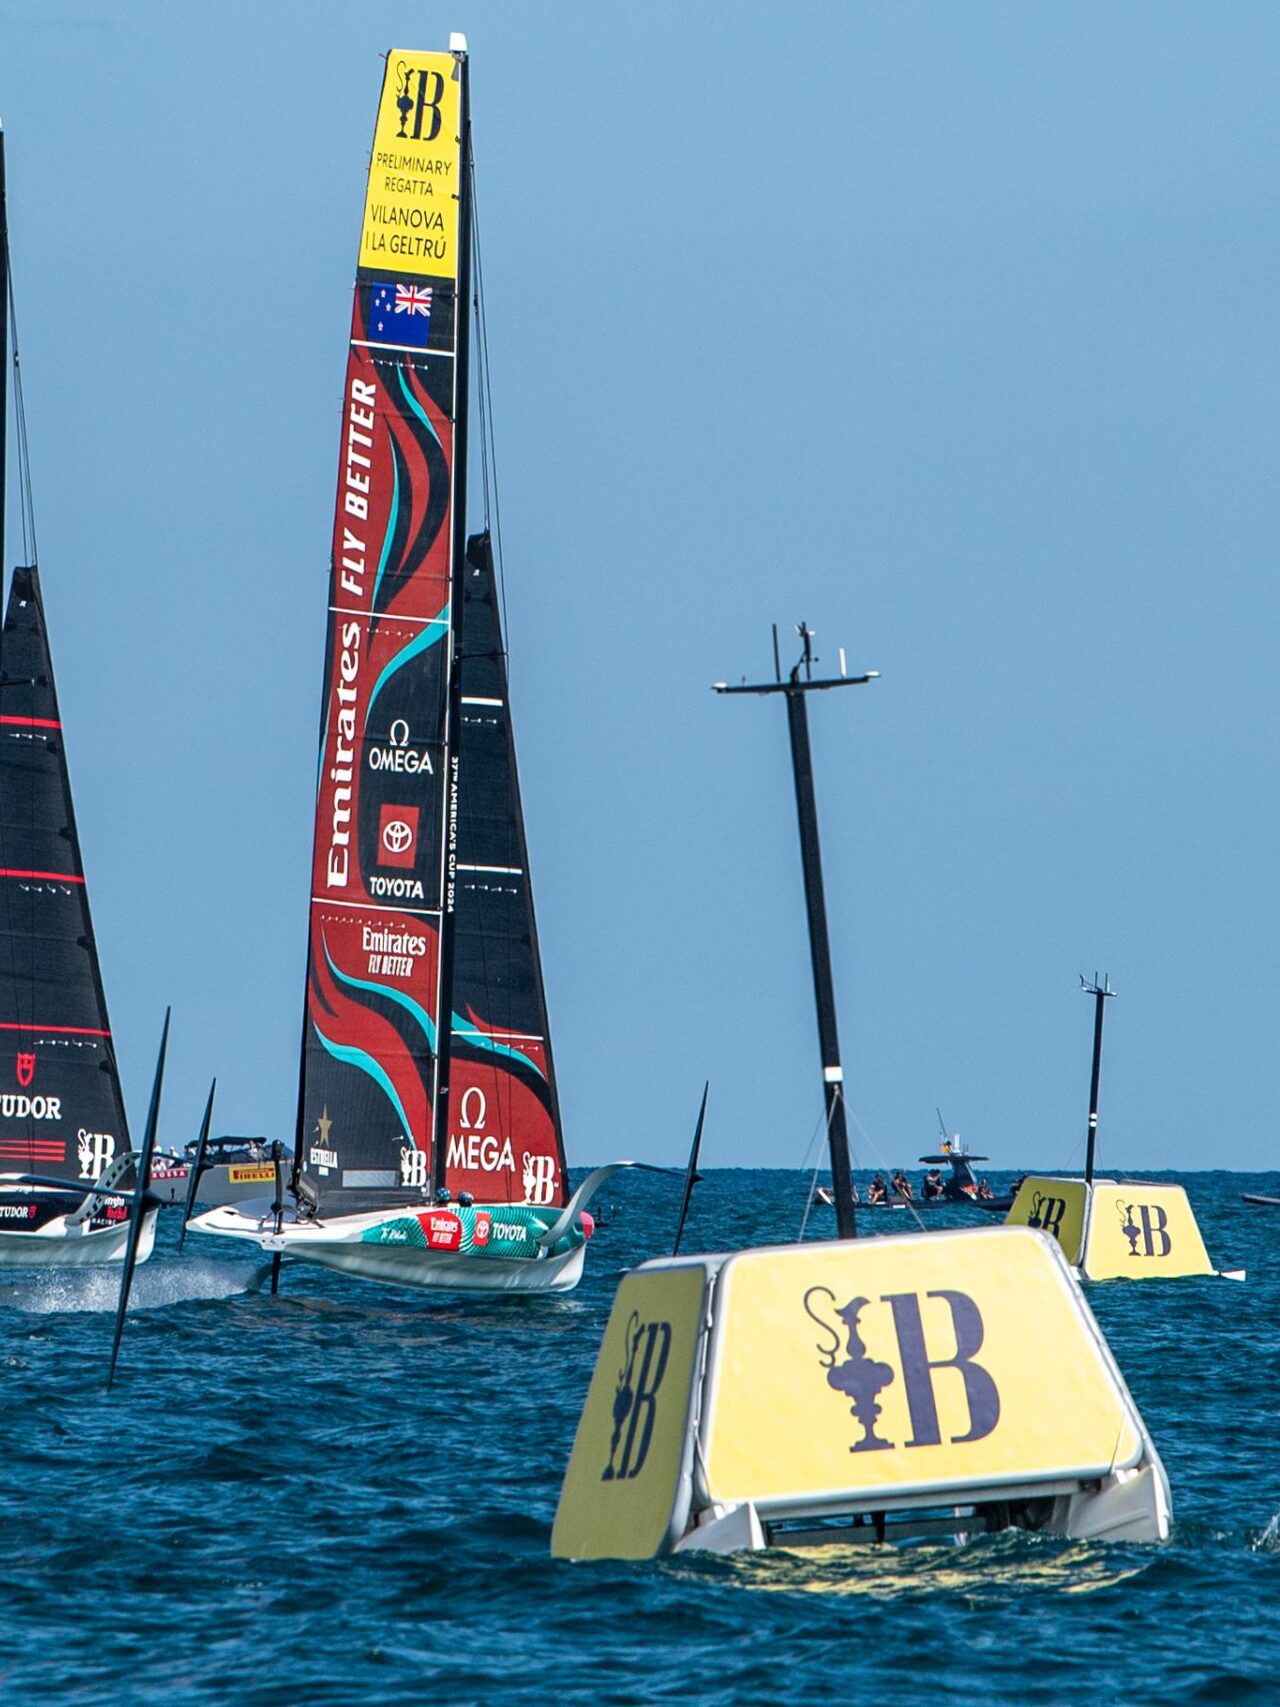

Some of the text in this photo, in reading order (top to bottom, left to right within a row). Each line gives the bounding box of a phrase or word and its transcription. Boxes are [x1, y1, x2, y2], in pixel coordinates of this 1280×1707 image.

[376, 152, 452, 177] PRELIMINARY
[384, 177, 433, 197] REGATTA
[371, 204, 444, 231] VILANOVA
[365, 231, 446, 259] I LA GELTRÚ
[341, 378, 376, 596] FLY BETTER
[327, 621, 361, 888] Emirates
[369, 747, 434, 775] OMEGA
[449, 783, 458, 850] AMERICA'S
[448, 853, 457, 880] CUP
[369, 876, 424, 899] TOYOTA
[447, 882, 455, 913] 2024
[362, 926, 427, 956] Emirates
[368, 954, 413, 976] FLY BETTER
[446, 1133, 515, 1173] MEGA
[0, 1207, 29, 1218] TUDOR
[492, 1223, 527, 1242] TOYOTA
[880, 1289, 1001, 1448] B
